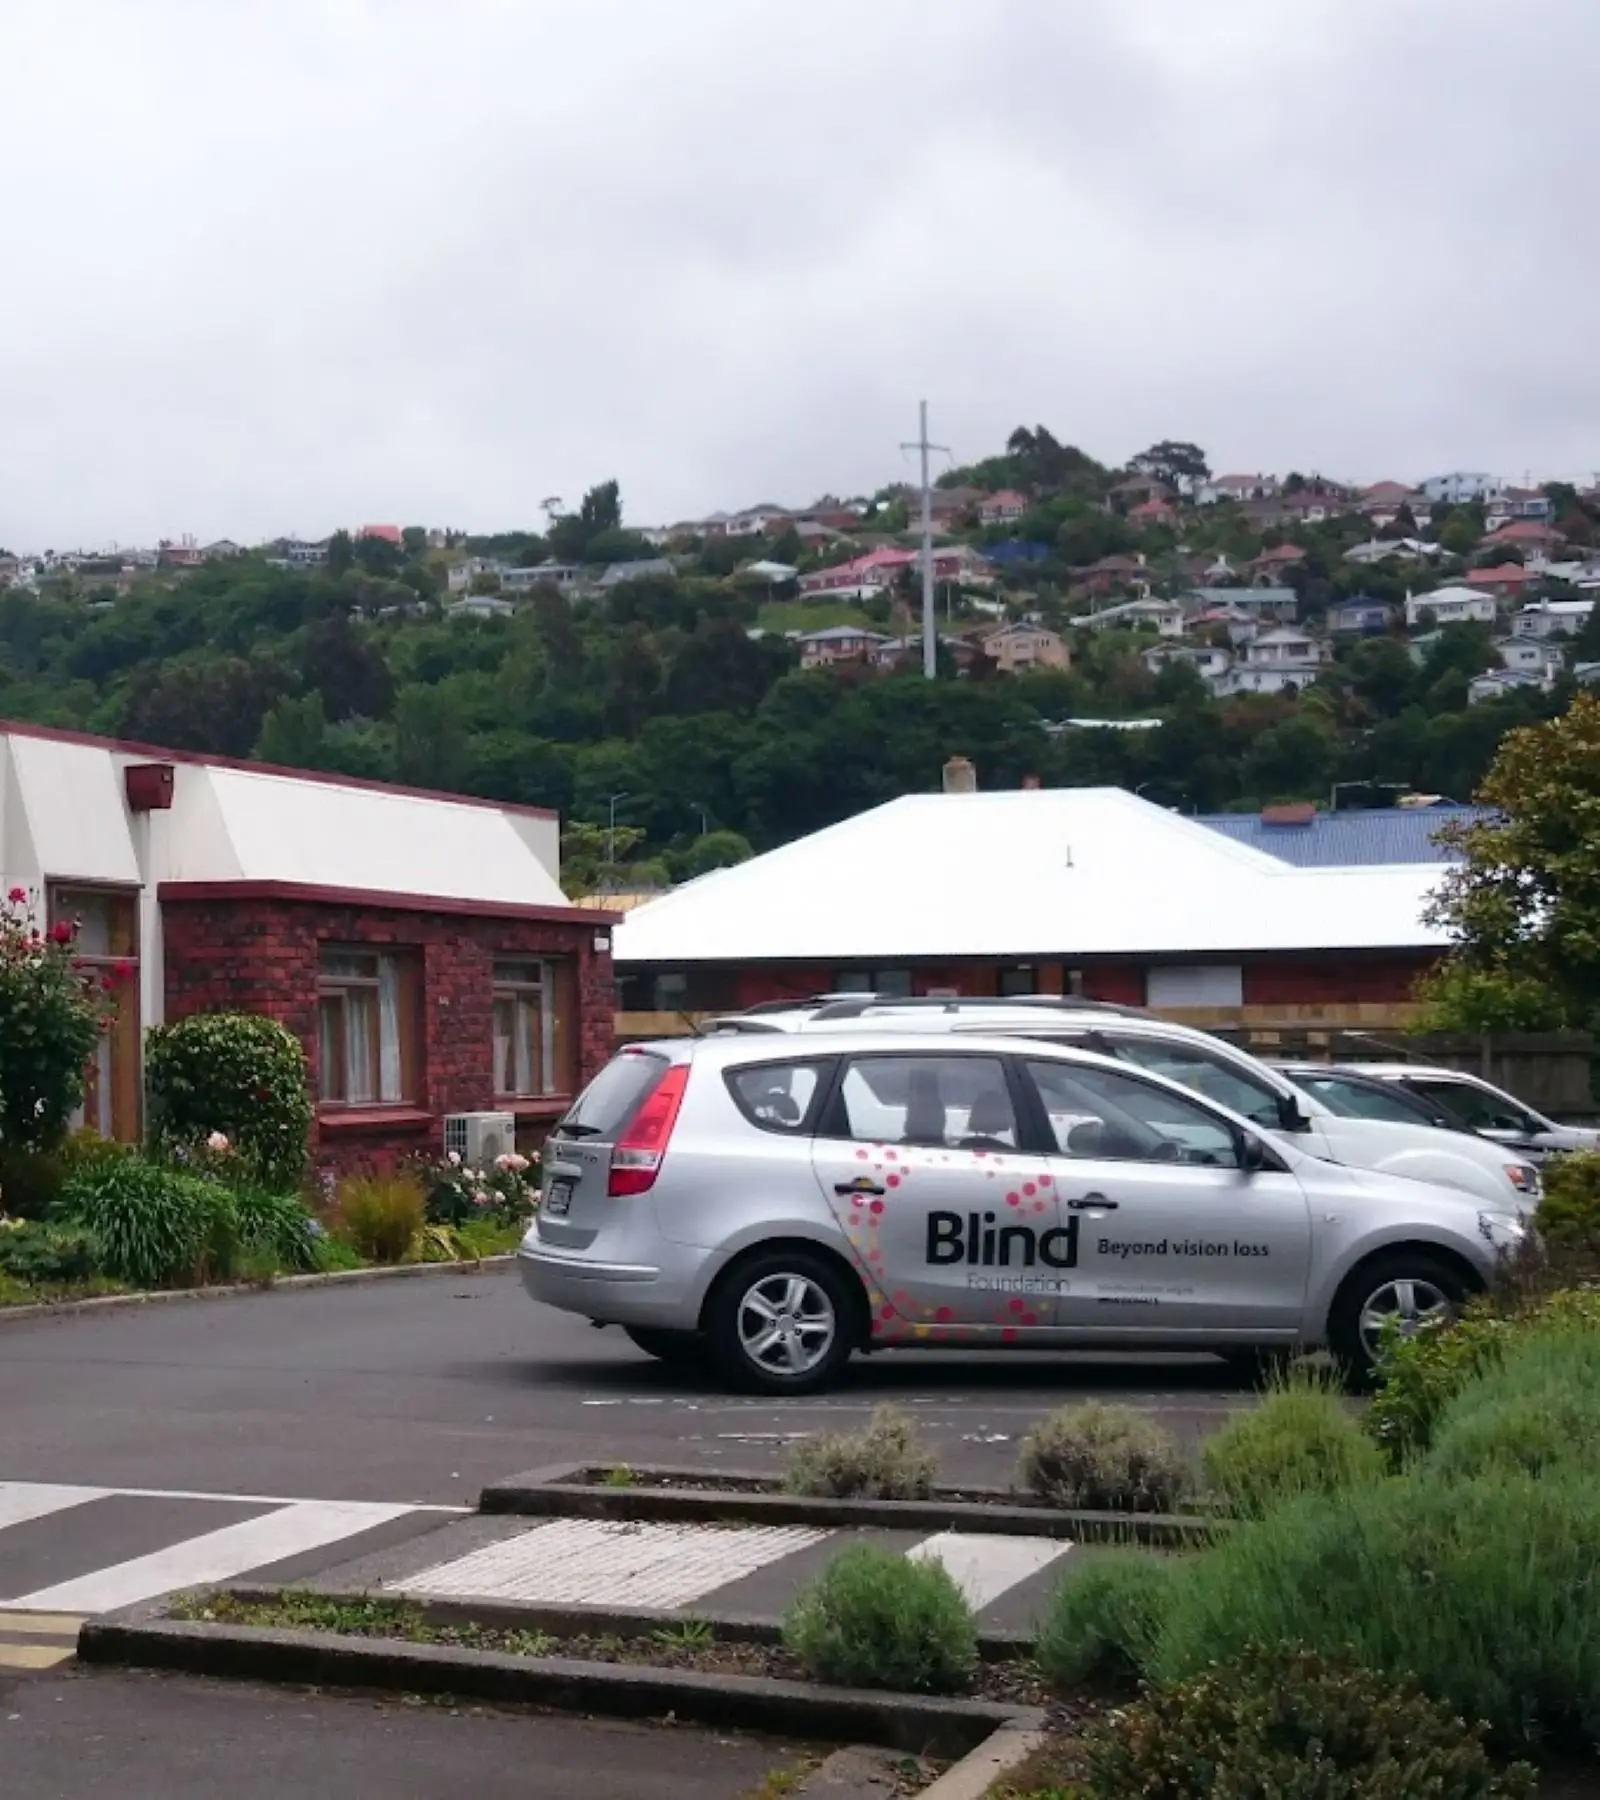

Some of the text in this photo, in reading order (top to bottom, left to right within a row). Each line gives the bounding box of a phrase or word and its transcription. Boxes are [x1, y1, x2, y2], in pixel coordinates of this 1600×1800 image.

[925, 1211, 1080, 1268] Blind
[1097, 1238, 1269, 1260] Beyond vision loss
[966, 1272, 1070, 1293] Foundation
